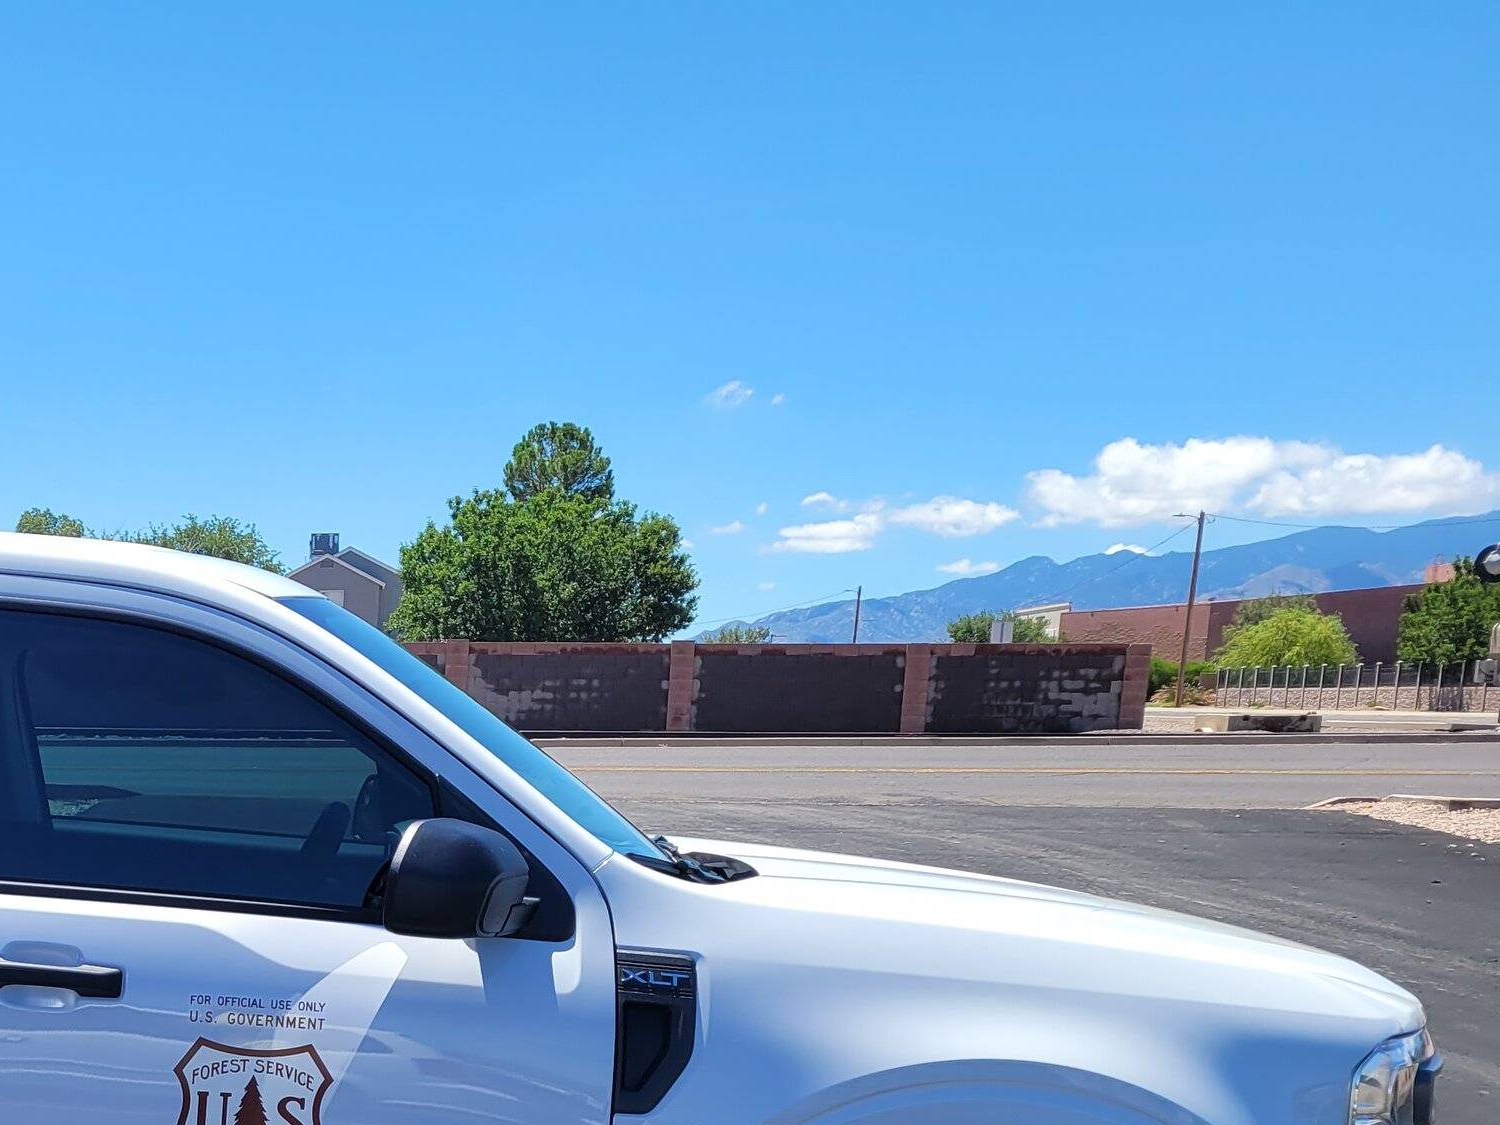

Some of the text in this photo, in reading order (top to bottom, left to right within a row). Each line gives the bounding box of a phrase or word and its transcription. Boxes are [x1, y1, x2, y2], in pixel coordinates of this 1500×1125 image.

[621, 968, 690, 987] XLT
[190, 994, 327, 1013] FOR OFFICIAL USE ONLY
[189, 1010, 326, 1031] U.S. GOVERNMENT
[191, 1058, 315, 1092] FOREST SERVICE
